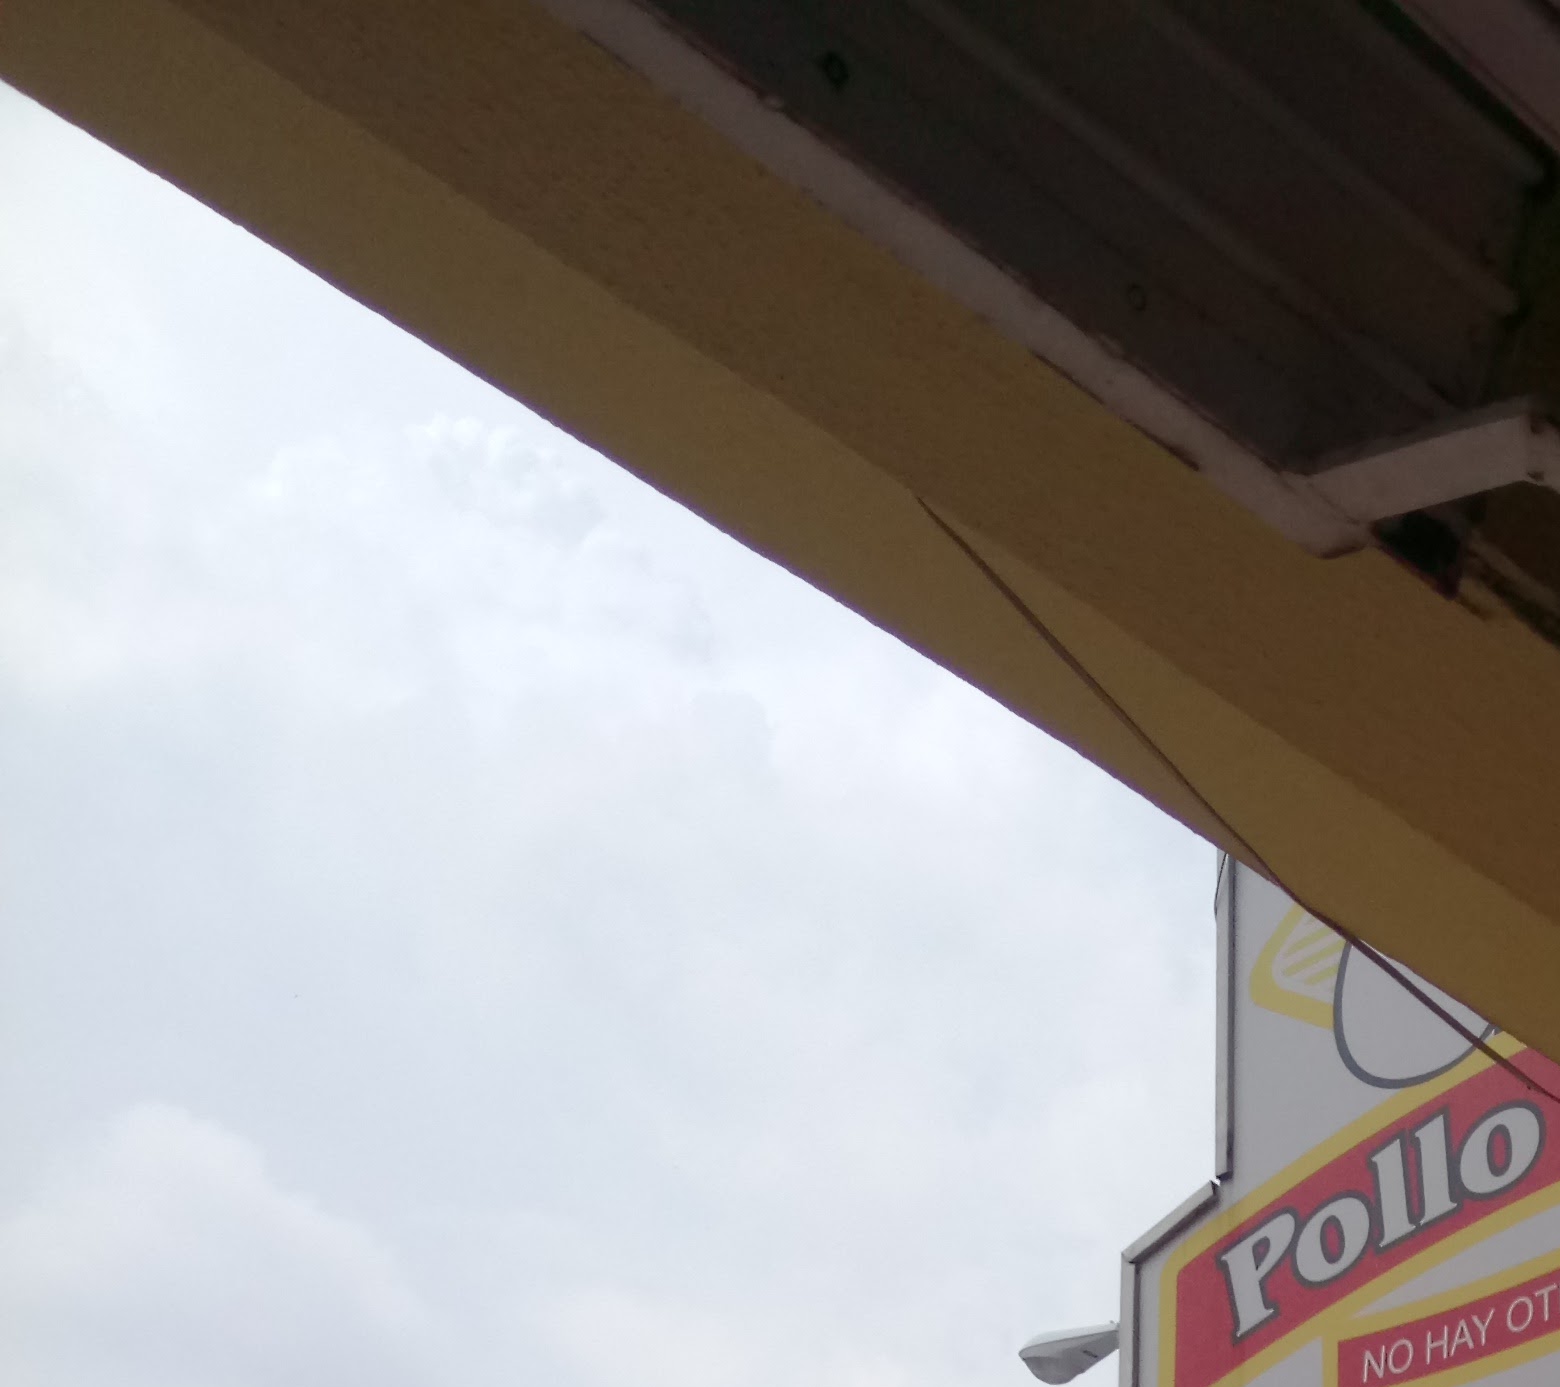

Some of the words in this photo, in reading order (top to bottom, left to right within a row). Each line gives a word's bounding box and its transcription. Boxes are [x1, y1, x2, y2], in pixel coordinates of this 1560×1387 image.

[1220, 1101, 1545, 1346] Pollo
[1361, 1337, 1414, 1385] NO
[1424, 1310, 1497, 1369] HAY
